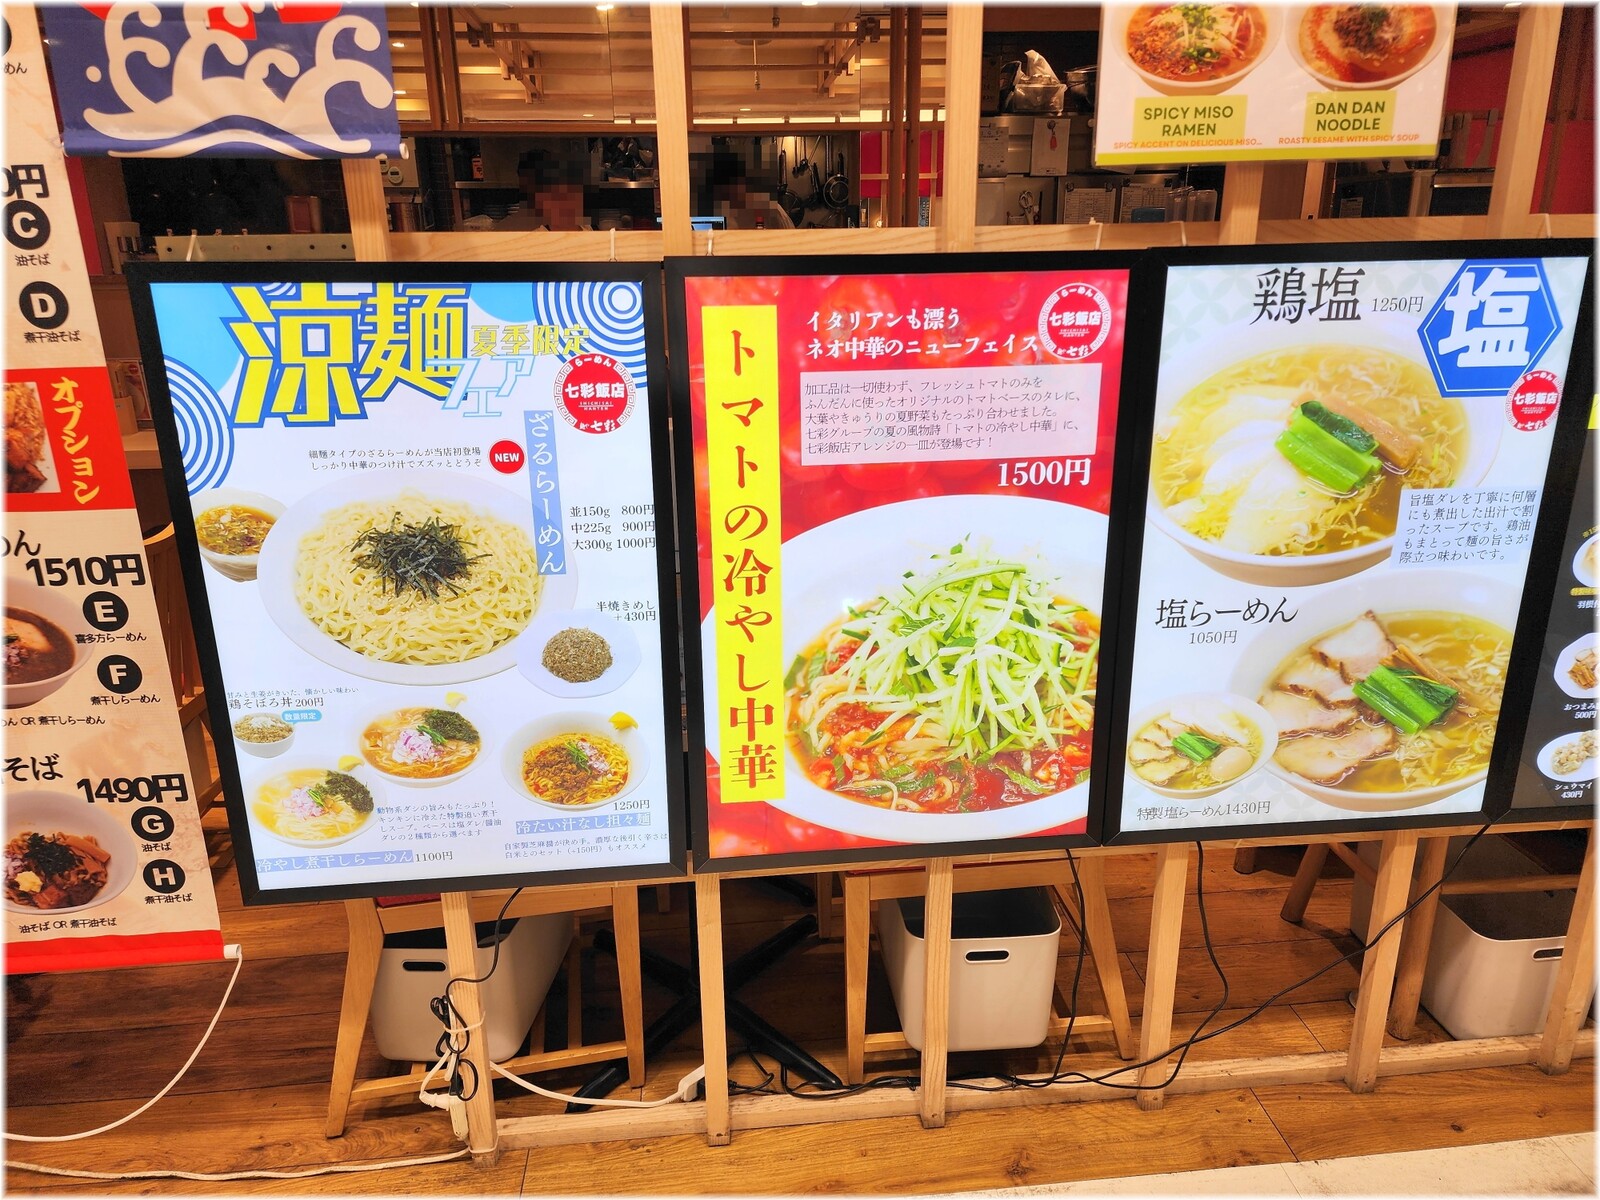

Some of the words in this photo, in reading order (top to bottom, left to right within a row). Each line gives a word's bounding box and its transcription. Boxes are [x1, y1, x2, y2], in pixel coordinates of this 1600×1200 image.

[1143, 106, 1189, 120] SPICY
[1194, 105, 1234, 119] MISO
[1315, 102, 1348, 115] DAN
[1352, 101, 1386, 114] DAN
[1162, 123, 1217, 137] RAMEN
[1316, 118, 1381, 132] NOODLE
[1113, 141, 1138, 150] SPICY
[1141, 140, 1176, 149] ACCENT
[1177, 140, 1189, 148] ON
[1191, 139, 1234, 147] DELICIOUS
[1278, 136, 1311, 144] ROASTY
[1312, 136, 1345, 144] SESAME
[1370, 134, 1396, 142] SPICY
[1397, 134, 1420, 142] SOUP
[12, 211, 39, 239] C
[15, 253, 51, 266] 油そば
[1249, 266, 1366, 326] 鶏塩
[1371, 295, 1424, 313] 1250円
[29, 293, 57, 319] D
[806, 308, 960, 331] イタリアンも漂う
[1048, 310, 1102, 326] 七彩飯店
[1438, 268, 1541, 368] 塩
[24, 331, 81, 343] 煮干油そば
[471, 324, 592, 356] 夏季限定
[222, 282, 471, 427] 涼麺
[806, 333, 1039, 360] ネオ中華のニューフェイス
[575, 355, 612, 367] らーめん
[564, 382, 625, 398] 七彩飯店
[804, 376, 1043, 396] 加工品は一切使わず、フレッシュトマトのみを
[805, 391, 1081, 410] ふんだんに使ったオリジナルのトマトベースのタレに、
[805, 406, 1058, 425] 大葉やきゅうりの夏野菜もたっぷり合わせました。
[51, 376, 100, 505] オプション
[494, 452, 520, 463] NEW
[998, 457, 1092, 487] 1500円
[528, 412, 564, 574] ざるらーめん
[1410, 490, 1538, 507] 旨塩ダレを丁寧に何層
[570, 506, 611, 518] 並150g
[621, 504, 655, 516] 800円
[1408, 504, 1535, 521] にも煮出した出汁で割
[570, 522, 612, 534] 中225g
[622, 520, 656, 532] 900円
[1406, 519, 1532, 535] ったスープです。鶏油
[572, 539, 613, 552] 大300g
[616, 537, 656, 549] 1000円
[1404, 534, 1529, 550] もまとって麺の旨さが
[722, 329, 776, 789] トマトの冷やし中華
[1399, 548, 1506, 564] 際立つ味わいです。
[26, 553, 146, 586] 1510円
[94, 600, 118, 623] E
[1154, 597, 1300, 629] 塩らーめん
[75, 632, 147, 644] 喜多方らーめん
[1188, 630, 1238, 645] 1050円
[109, 664, 127, 685] F
[90, 695, 161, 706] 煮干しらーめん
[20, 716, 36, 726] OR
[39, 715, 106, 726] 煮干しらーめん
[1574, 711, 1598, 719] 500円
[76, 773, 190, 804] 1490円
[1554, 782, 1593, 790] シュウマイ
[1560, 790, 1584, 799] 430円
[613, 800, 650, 811] 1250円
[141, 814, 166, 835] G
[516, 813, 651, 834] 冷たい汁なし担々麺
[142, 842, 172, 852] 油そば
[257, 851, 413, 872] 冷やし煮干しらーめん
[416, 850, 454, 862] 1100円
[154, 867, 175, 886] H
[19, 922, 50, 934] 油そば
[53, 920, 67, 929] OR
